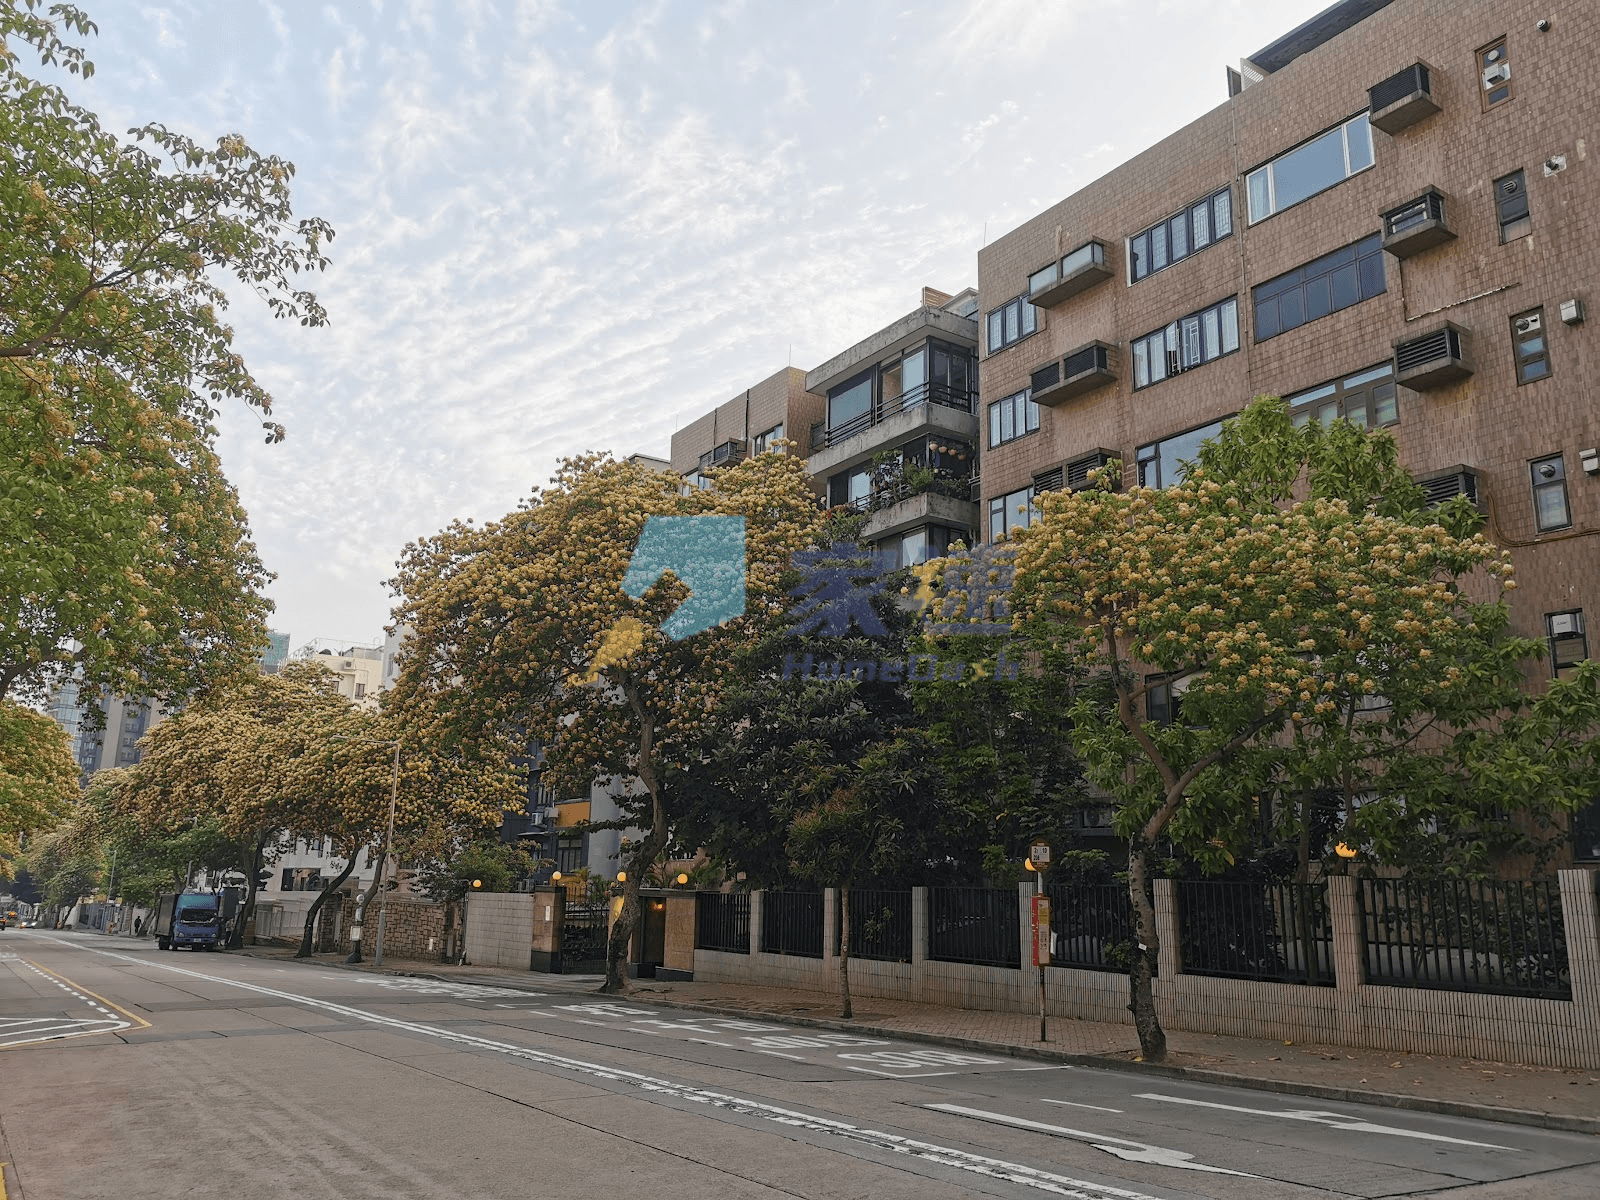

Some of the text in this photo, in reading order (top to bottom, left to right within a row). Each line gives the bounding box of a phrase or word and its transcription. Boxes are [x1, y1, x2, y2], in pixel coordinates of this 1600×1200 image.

[630, 1017, 791, 1034] 巴士
[739, 1034, 892, 1049] STOP
[836, 1050, 1006, 1069] BUS
